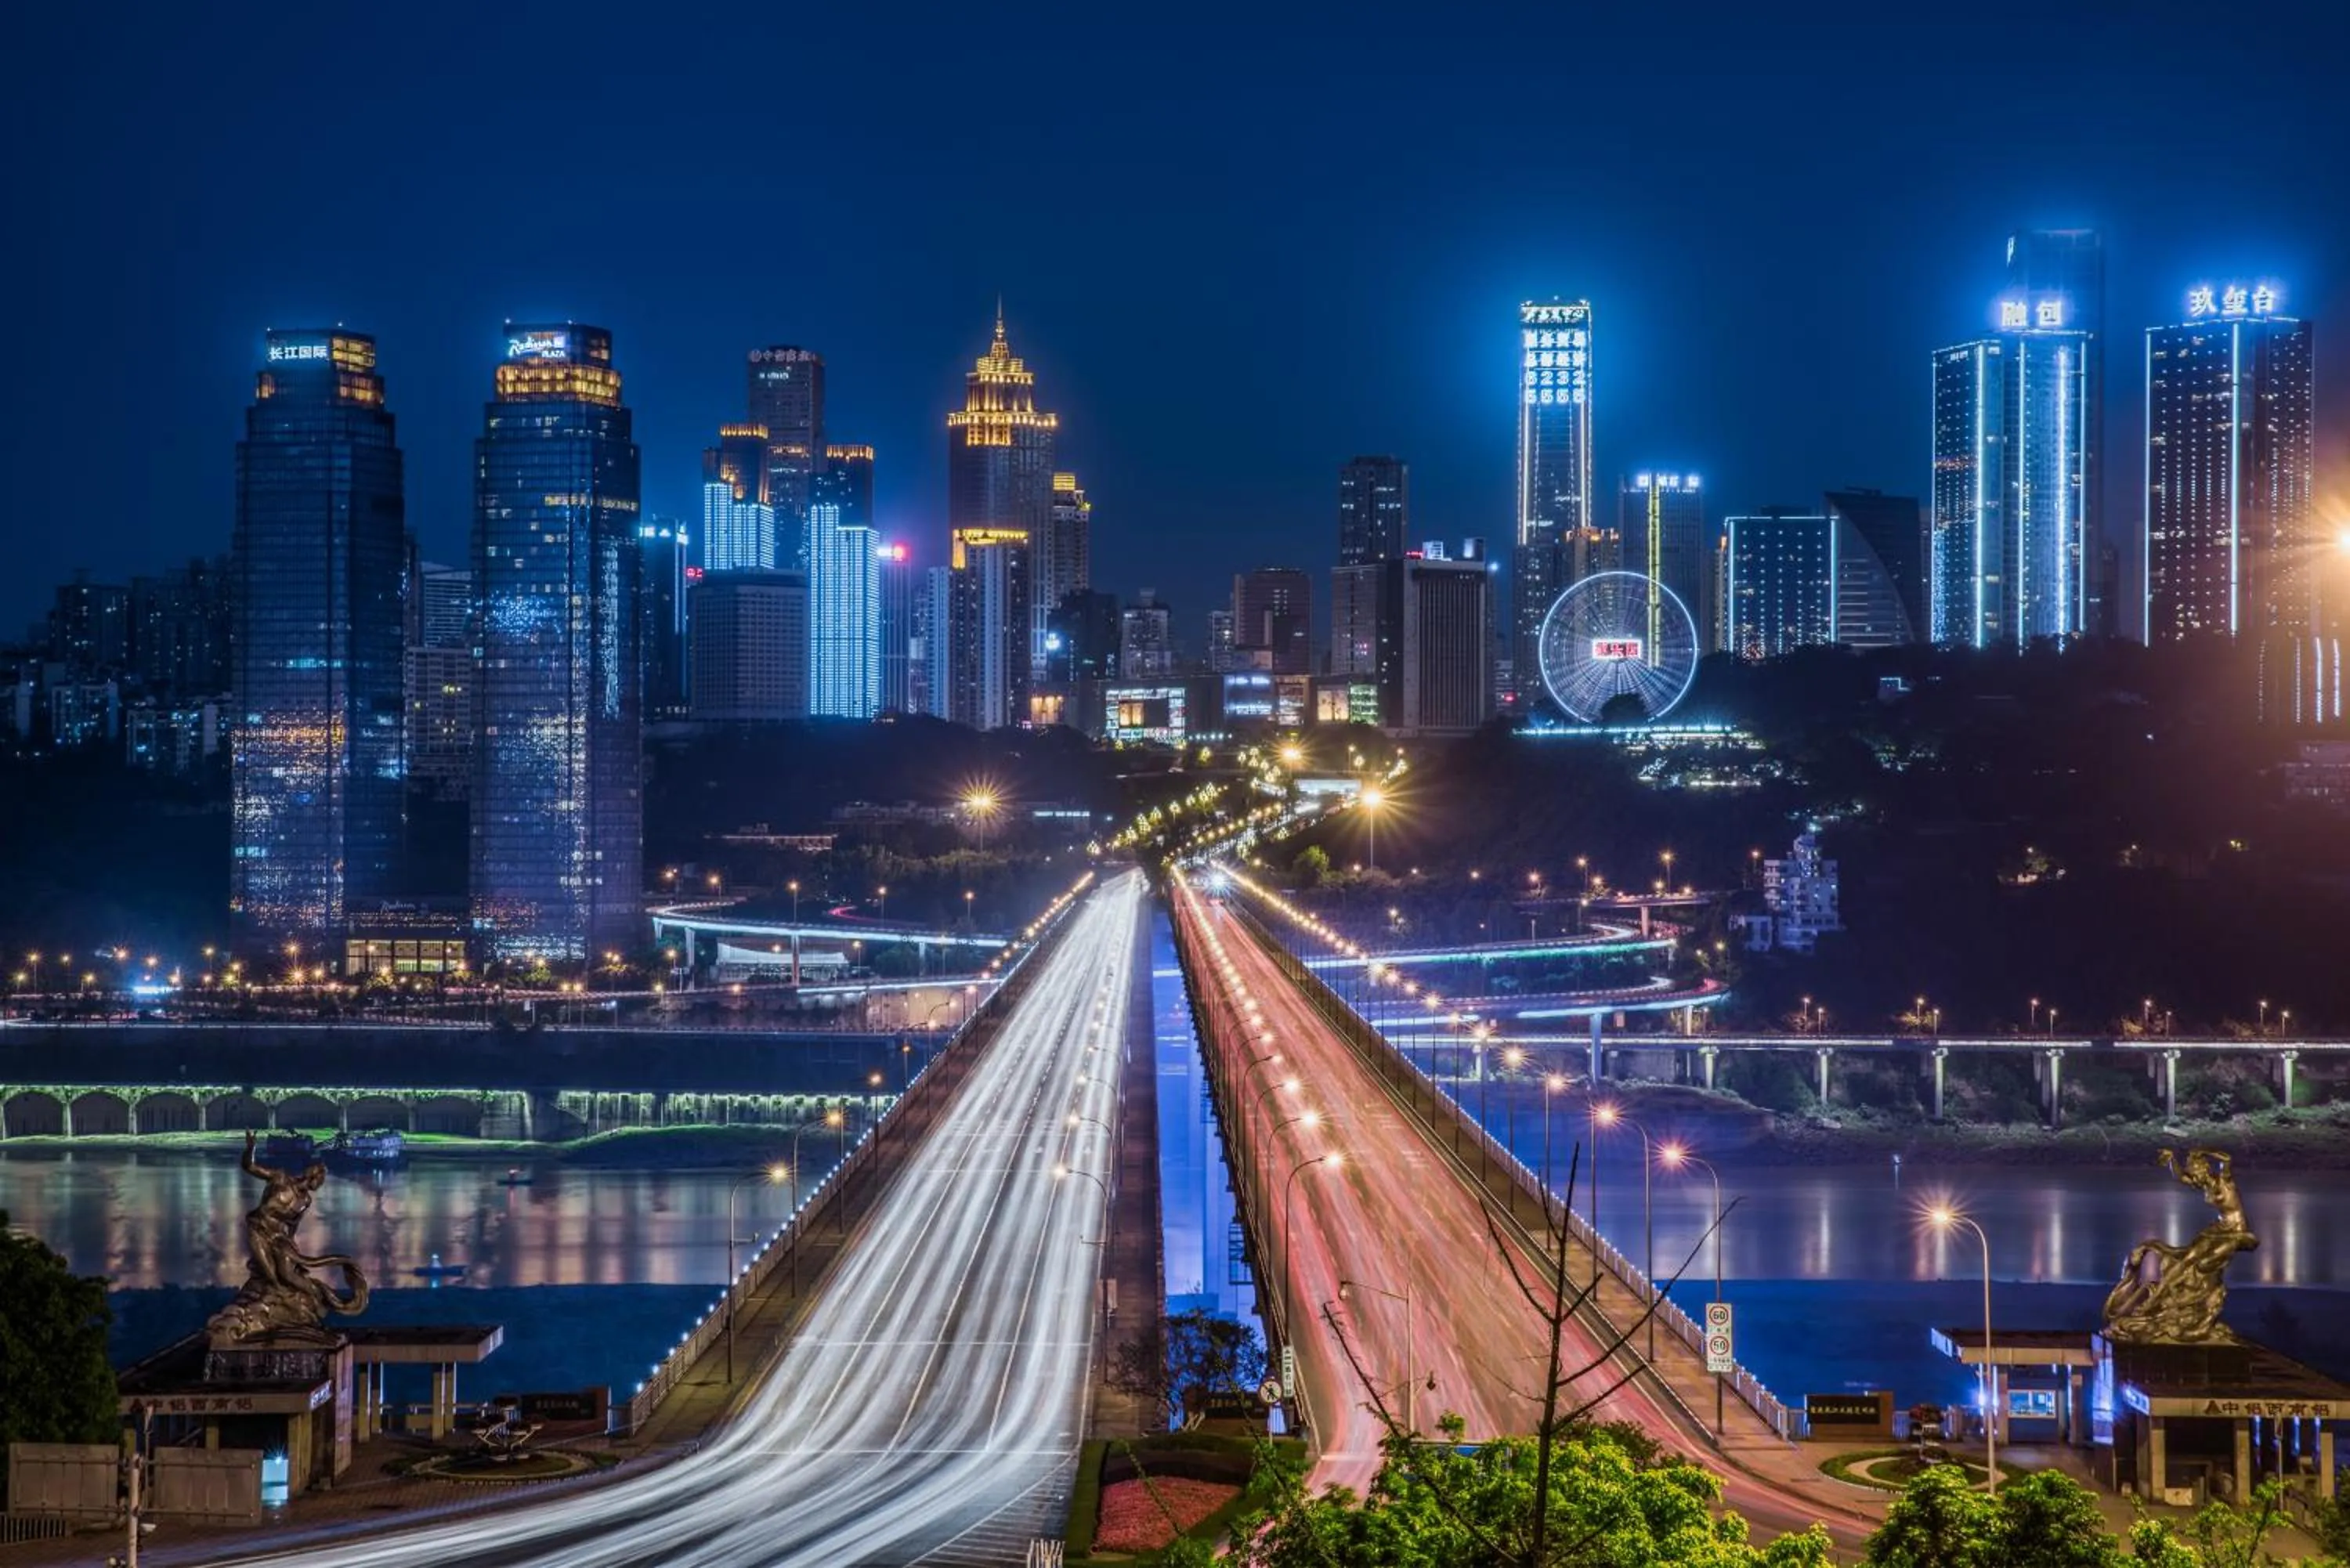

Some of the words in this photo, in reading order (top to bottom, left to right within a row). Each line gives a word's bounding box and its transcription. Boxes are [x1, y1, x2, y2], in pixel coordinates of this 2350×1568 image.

[269, 345, 328, 360] 长江国际
[1713, 1310, 1726, 1320] 60
[1713, 1340, 1726, 1350] 50
